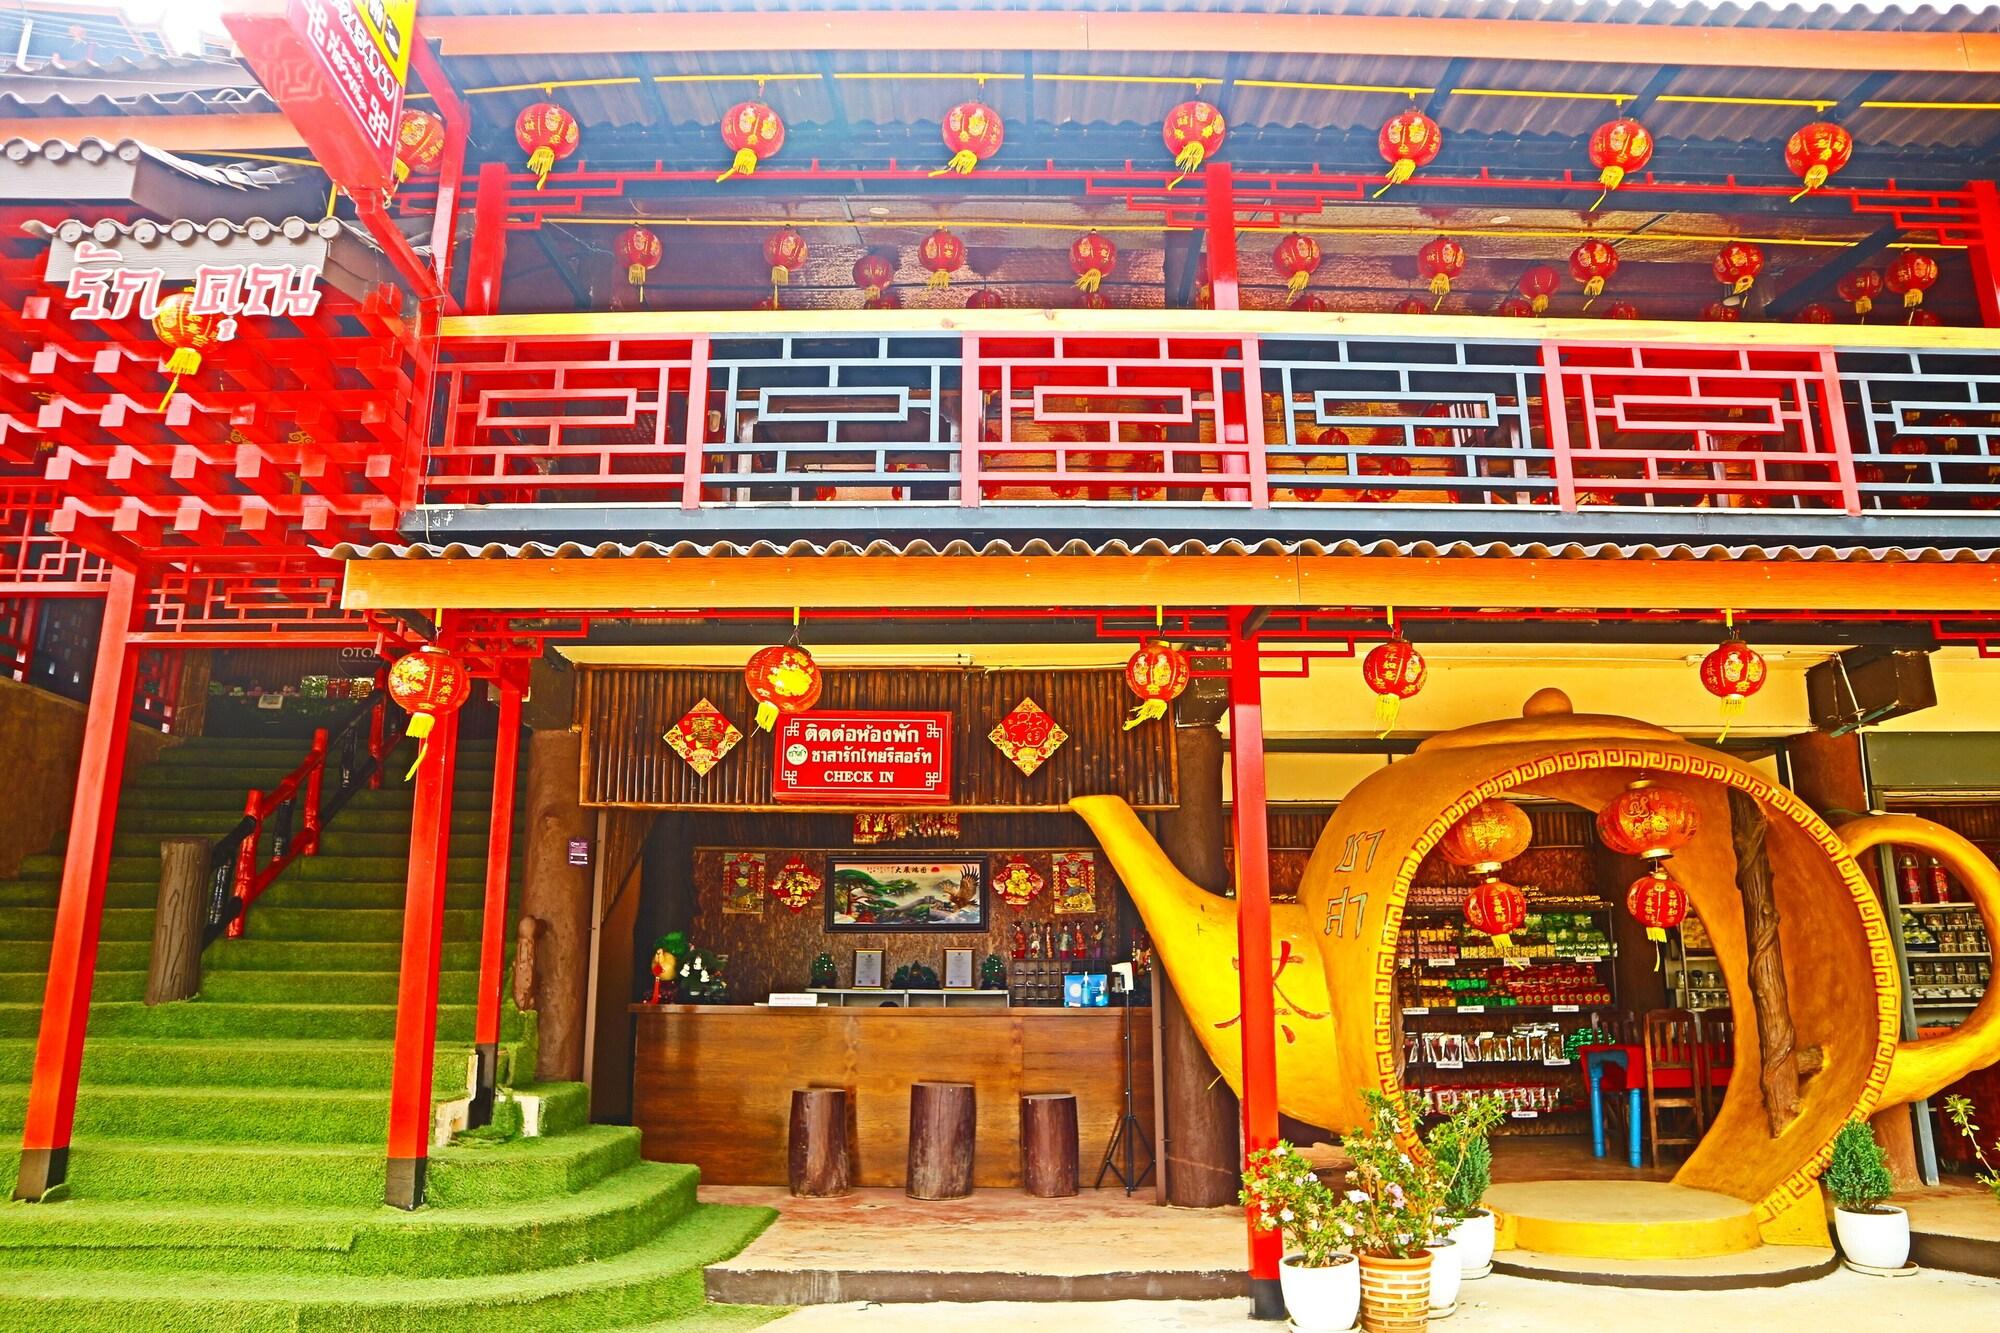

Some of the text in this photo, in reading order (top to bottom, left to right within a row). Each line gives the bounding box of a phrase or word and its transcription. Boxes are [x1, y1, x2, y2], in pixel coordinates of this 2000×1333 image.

[66, 240, 322, 341] รัก คุณ
[804, 723, 919, 743] ติดต่อห้องพัก
[811, 745, 932, 764] ชาสารักไทยรีสอร์ท
[823, 770, 895, 783] CHECK IN
[1334, 828, 1387, 873] ชา
[1324, 886, 1368, 940] สา
